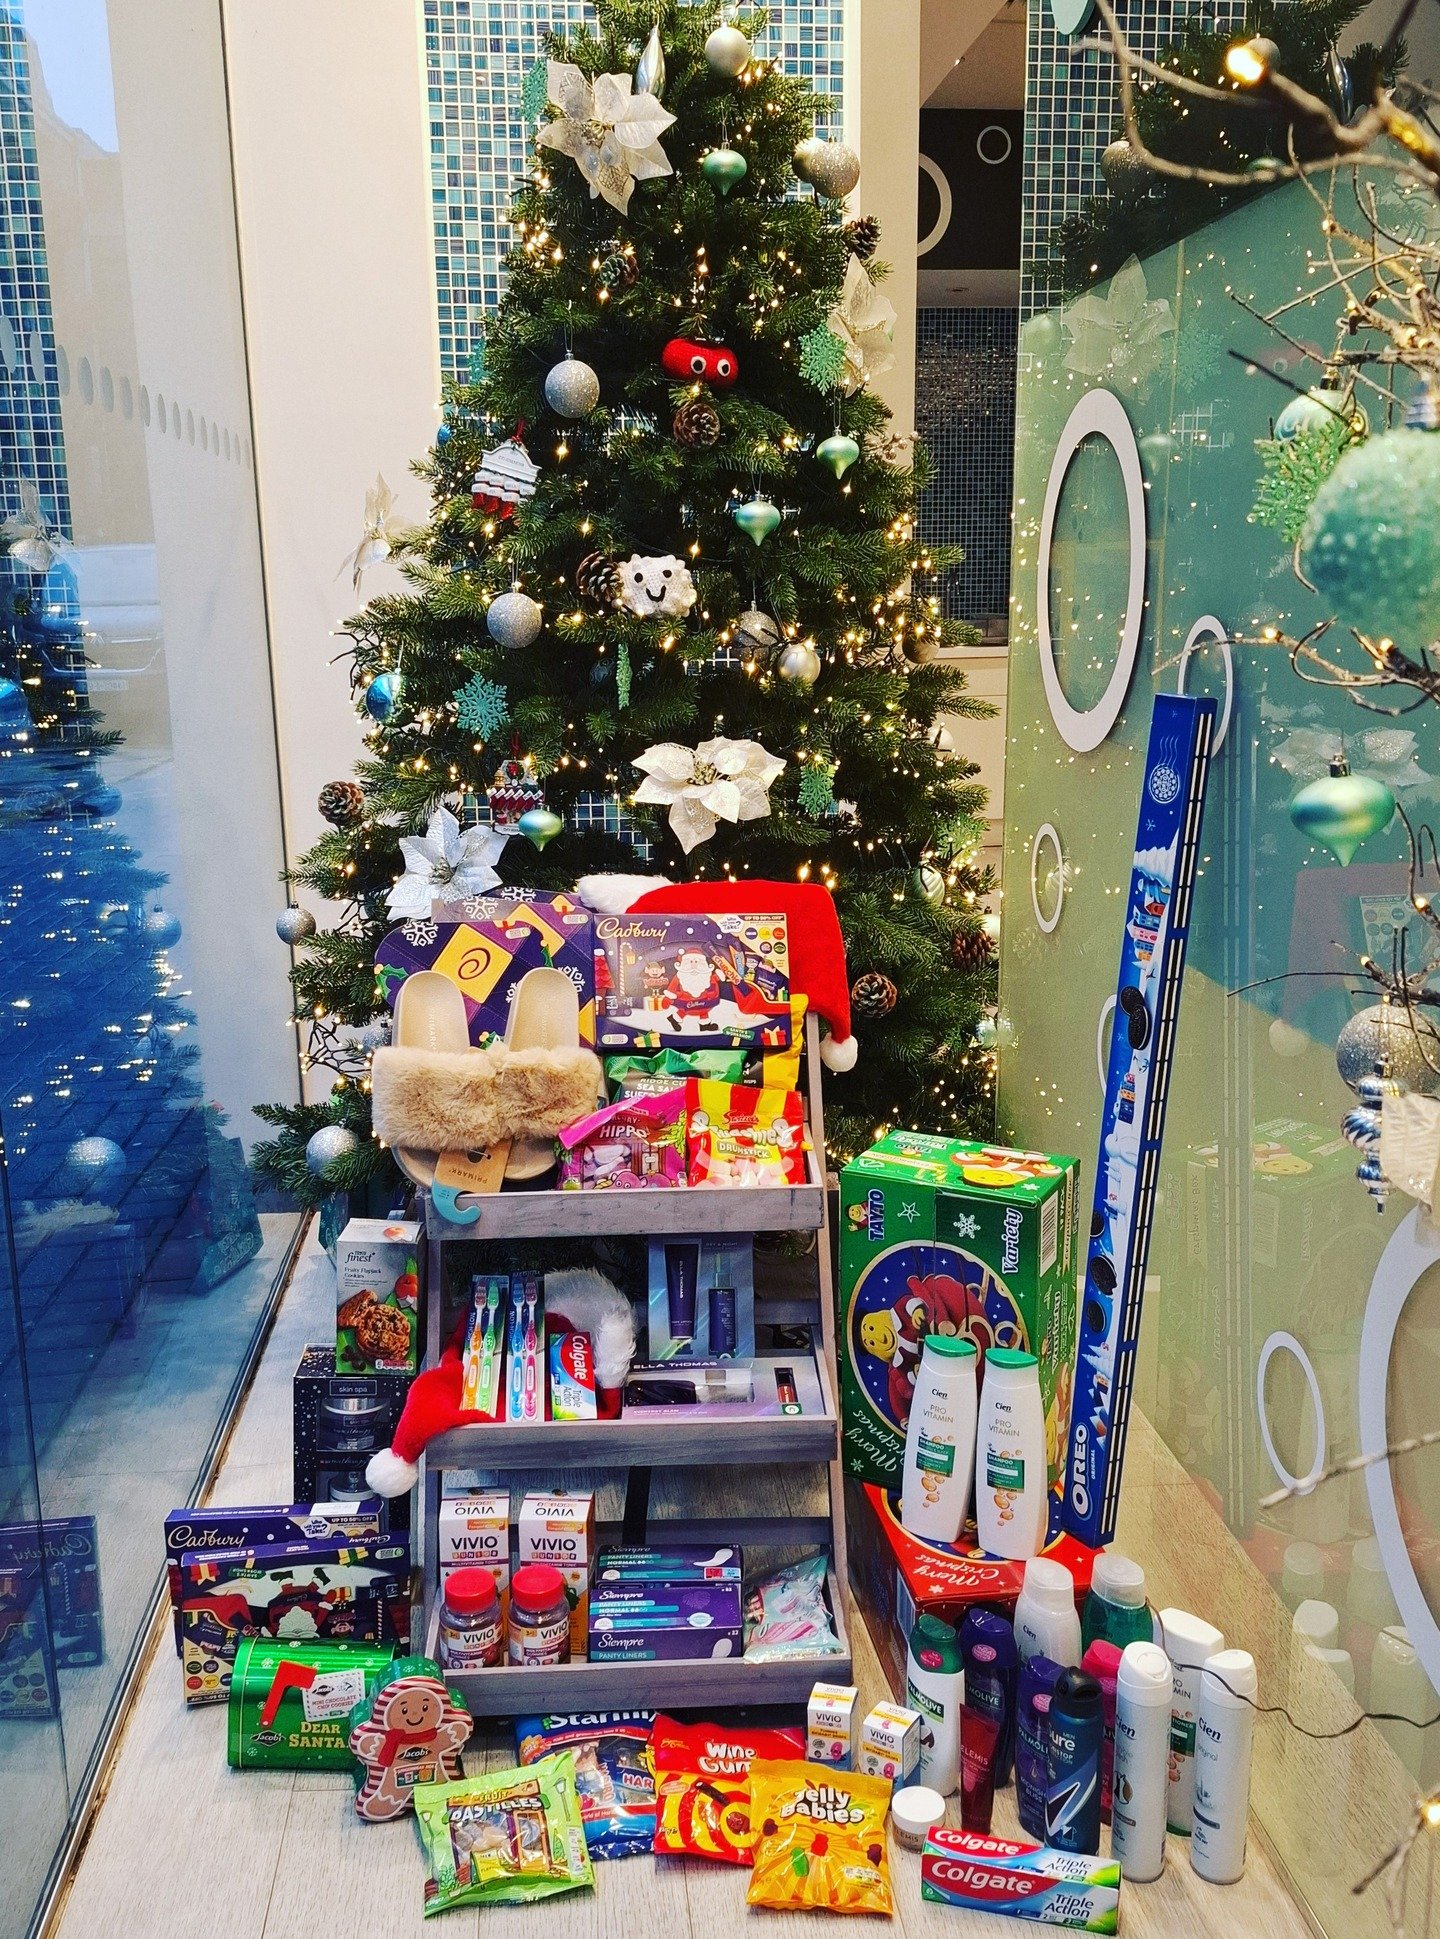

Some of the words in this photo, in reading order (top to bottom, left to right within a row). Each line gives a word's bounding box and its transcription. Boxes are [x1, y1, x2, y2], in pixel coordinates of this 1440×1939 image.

[596, 917, 667, 942] Cadbury
[636, 1083, 655, 1091] SEA
[719, 1142, 769, 1158] DRUMSTICK
[449, 1167, 489, 1184] PRIMARK
[868, 1189, 885, 1242] TAYTO
[1002, 1207, 1024, 1275] Variety
[569, 1335, 588, 1380] Colgate
[563, 1386, 573, 1407] Action
[573, 1386, 582, 1408] Triple
[931, 1388, 949, 1400] Cien
[923, 1409, 954, 1423] VITAMIN
[930, 1404, 947, 1415] PRO
[995, 1402, 1013, 1413] Cien
[988, 1424, 1021, 1437] VITAMIN
[995, 1418, 1012, 1429] PRO
[845, 1428, 897, 1473] Merry
[1072, 1424, 1089, 1515] OREO
[454, 1506, 495, 1516] VIVIO
[535, 1507, 575, 1517] VIVIO
[167, 1525, 246, 1549] Cadbury
[451, 1536, 498, 1550] VIVIO
[530, 1538, 577, 1551] VIVIO
[915, 1554, 1000, 1580] Crispmas
[913, 1566, 980, 1586] Merry
[598, 1590, 644, 1600] Siempre
[463, 1628, 495, 1644] VIVIO
[541, 1621, 568, 1640] VIVIO
[1022, 1625, 1037, 1640] Cien
[598, 1633, 644, 1650] Siempre
[325, 1695, 357, 1704] CHOCOLATE
[330, 1701, 354, 1709] COOKIES
[908, 1680, 943, 1715] PALMOLIVE
[816, 1712, 842, 1723] VIVIO
[1116, 1714, 1136, 1738] Cien
[300, 1721, 341, 1734] DEAR
[1063, 1731, 1076, 1740] MEN
[1199, 1716, 1222, 1740] Cien
[870, 1729, 895, 1744] VIVIO
[1018, 1726, 1048, 1755] PALMOLI
[706, 1741, 756, 1759] Wine
[623, 1773, 653, 1789] HAR
[480, 1790, 509, 1802] FRUIT
[794, 1787, 851, 1807] Jelly
[1025, 1786, 1043, 1803] BLISS
[451, 1798, 542, 1821] PASTILLES
[780, 1802, 865, 1823] Babies
[934, 1829, 1020, 1856] Colgate
[1045, 1862, 1089, 1877] Action
[1056, 1857, 1092, 1871] Triple
[931, 1861, 1033, 1894] Colgate
[1044, 1901, 1091, 1918] Action
[1055, 1893, 1094, 1910] Triple
